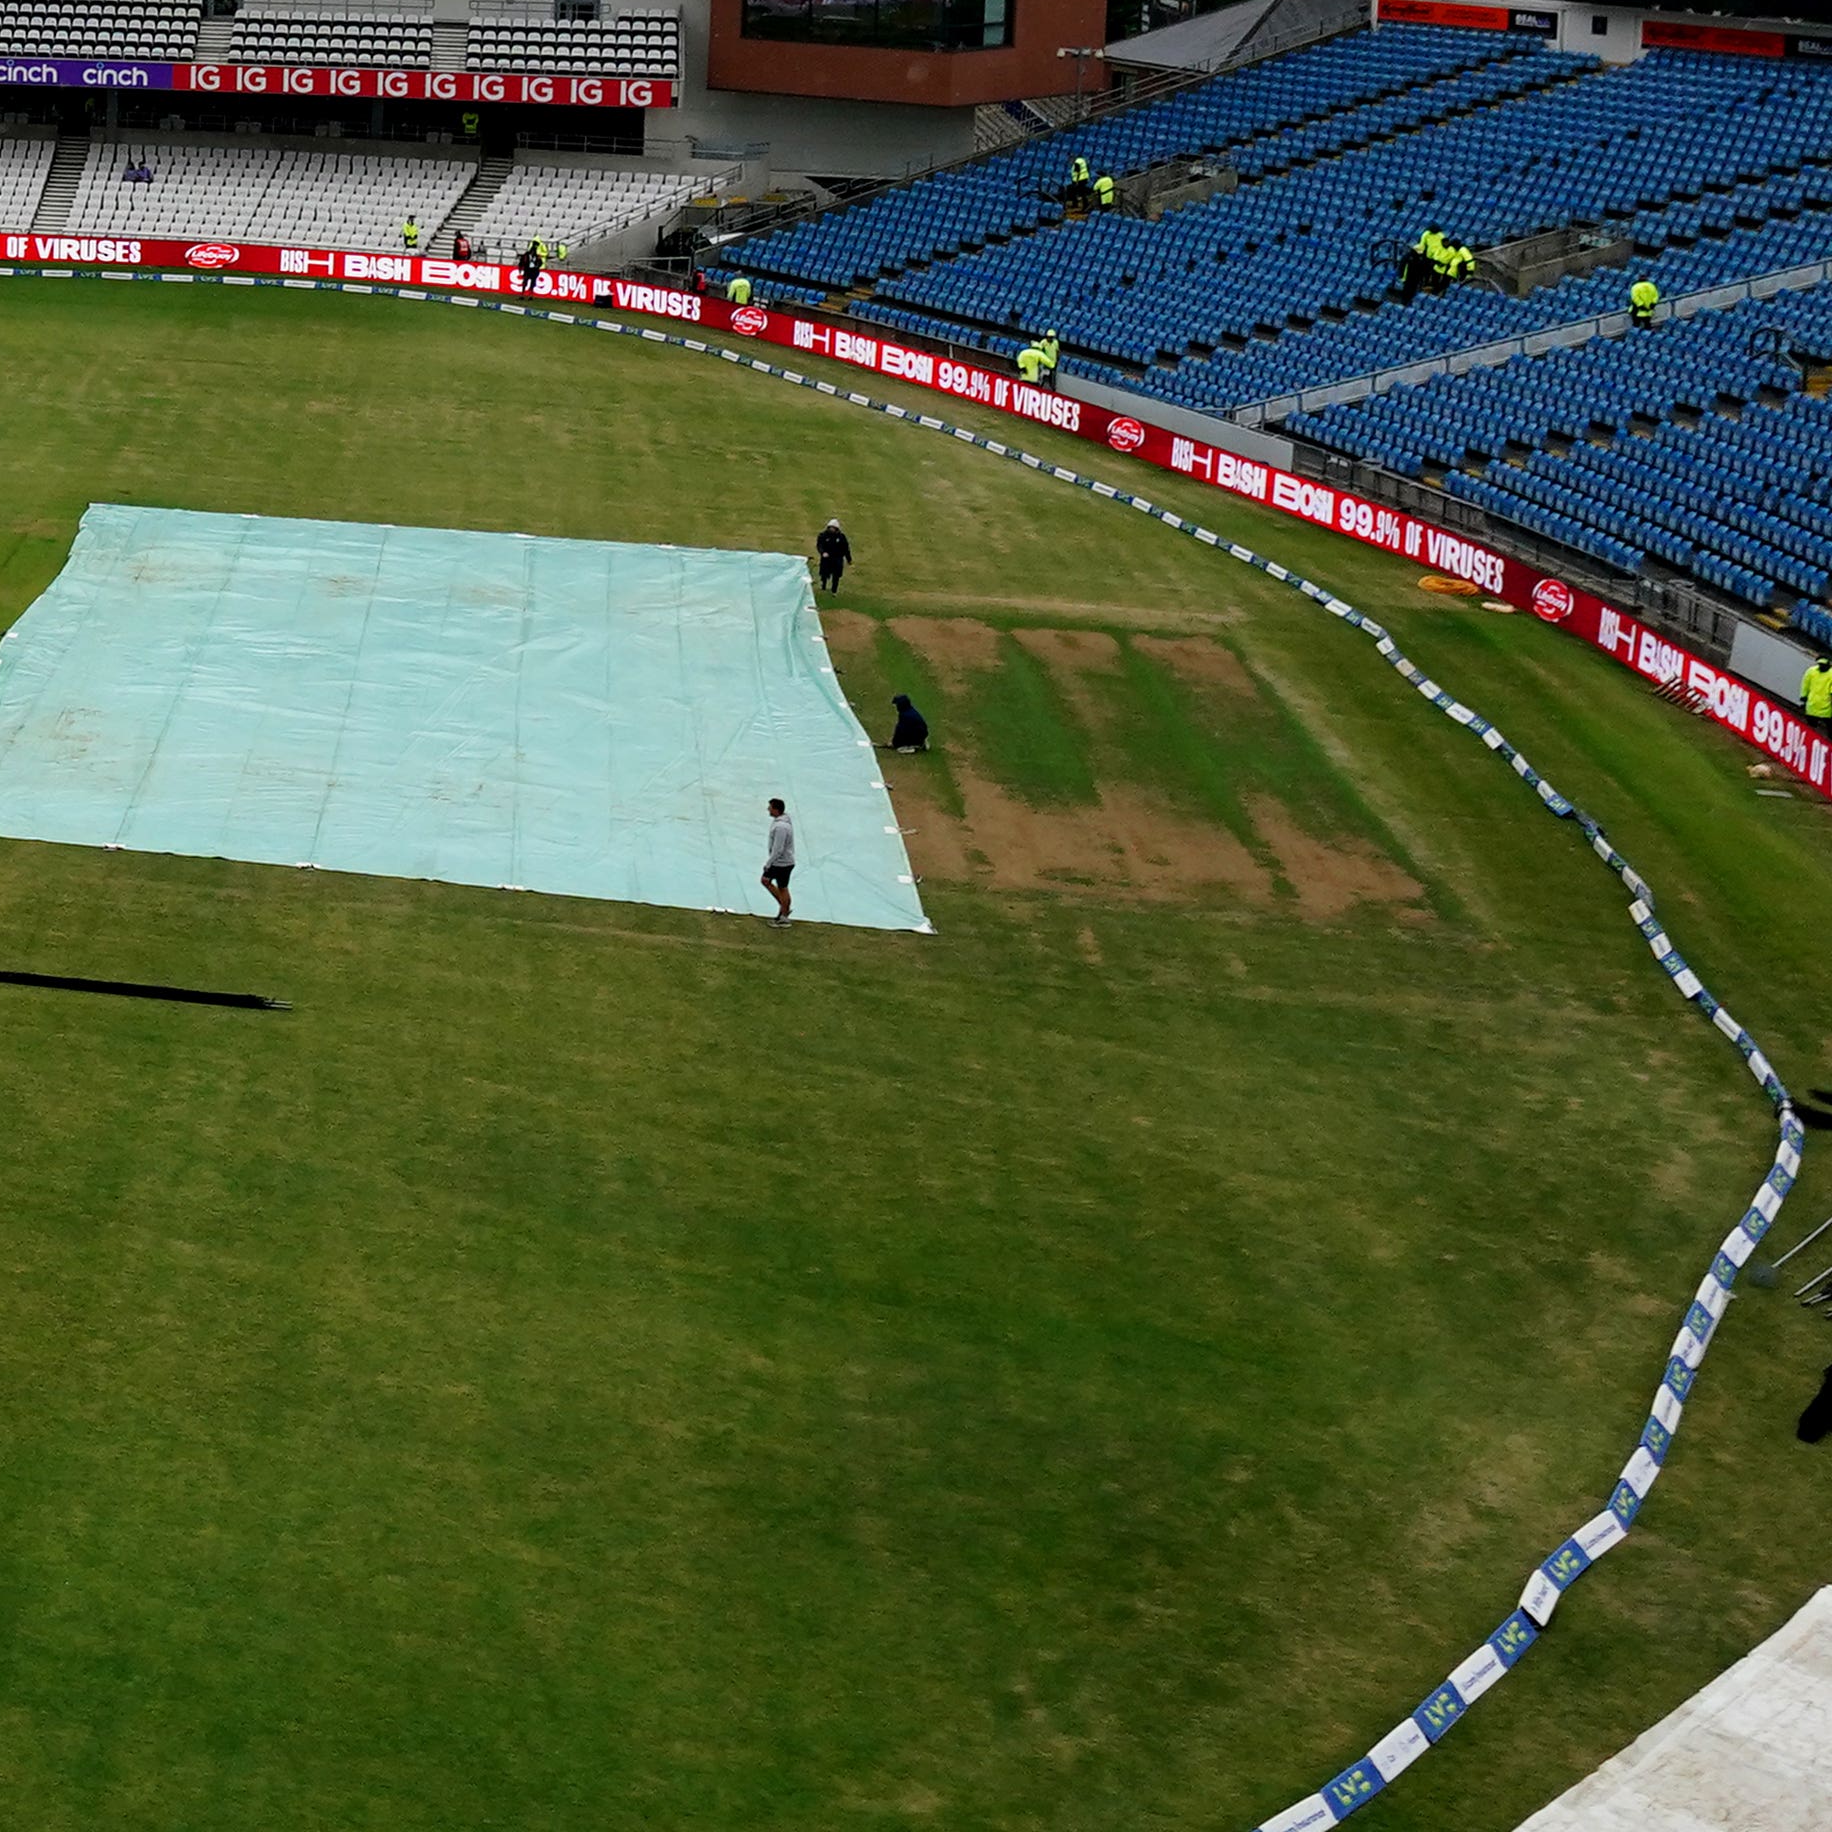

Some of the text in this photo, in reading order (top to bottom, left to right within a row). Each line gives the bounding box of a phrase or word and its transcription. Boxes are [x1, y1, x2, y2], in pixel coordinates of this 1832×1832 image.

[82, 61, 148, 87] cinch
[190, 65, 220, 90] IG
[329, 68, 361, 96] IG
[472, 73, 505, 102] IG
[619, 79, 653, 108] IG
[7, 236, 28, 258] OF
[35, 238, 141, 263] VIRUSES
[280, 249, 334, 275] BISH
[344, 253, 411, 282] BASH
[422, 258, 500, 290] BOSH
[616, 282, 701, 320] VIRUSES
[793, 319, 1080, 432] BISH BASH BOSH 99.9% OF VIRUSES
[1172, 438, 1504, 595] BISH BASH BOSH 99.9% OF VIRUSES
[1752, 700, 1807, 773] 99.9%
[1809, 738, 1828, 785] OF
